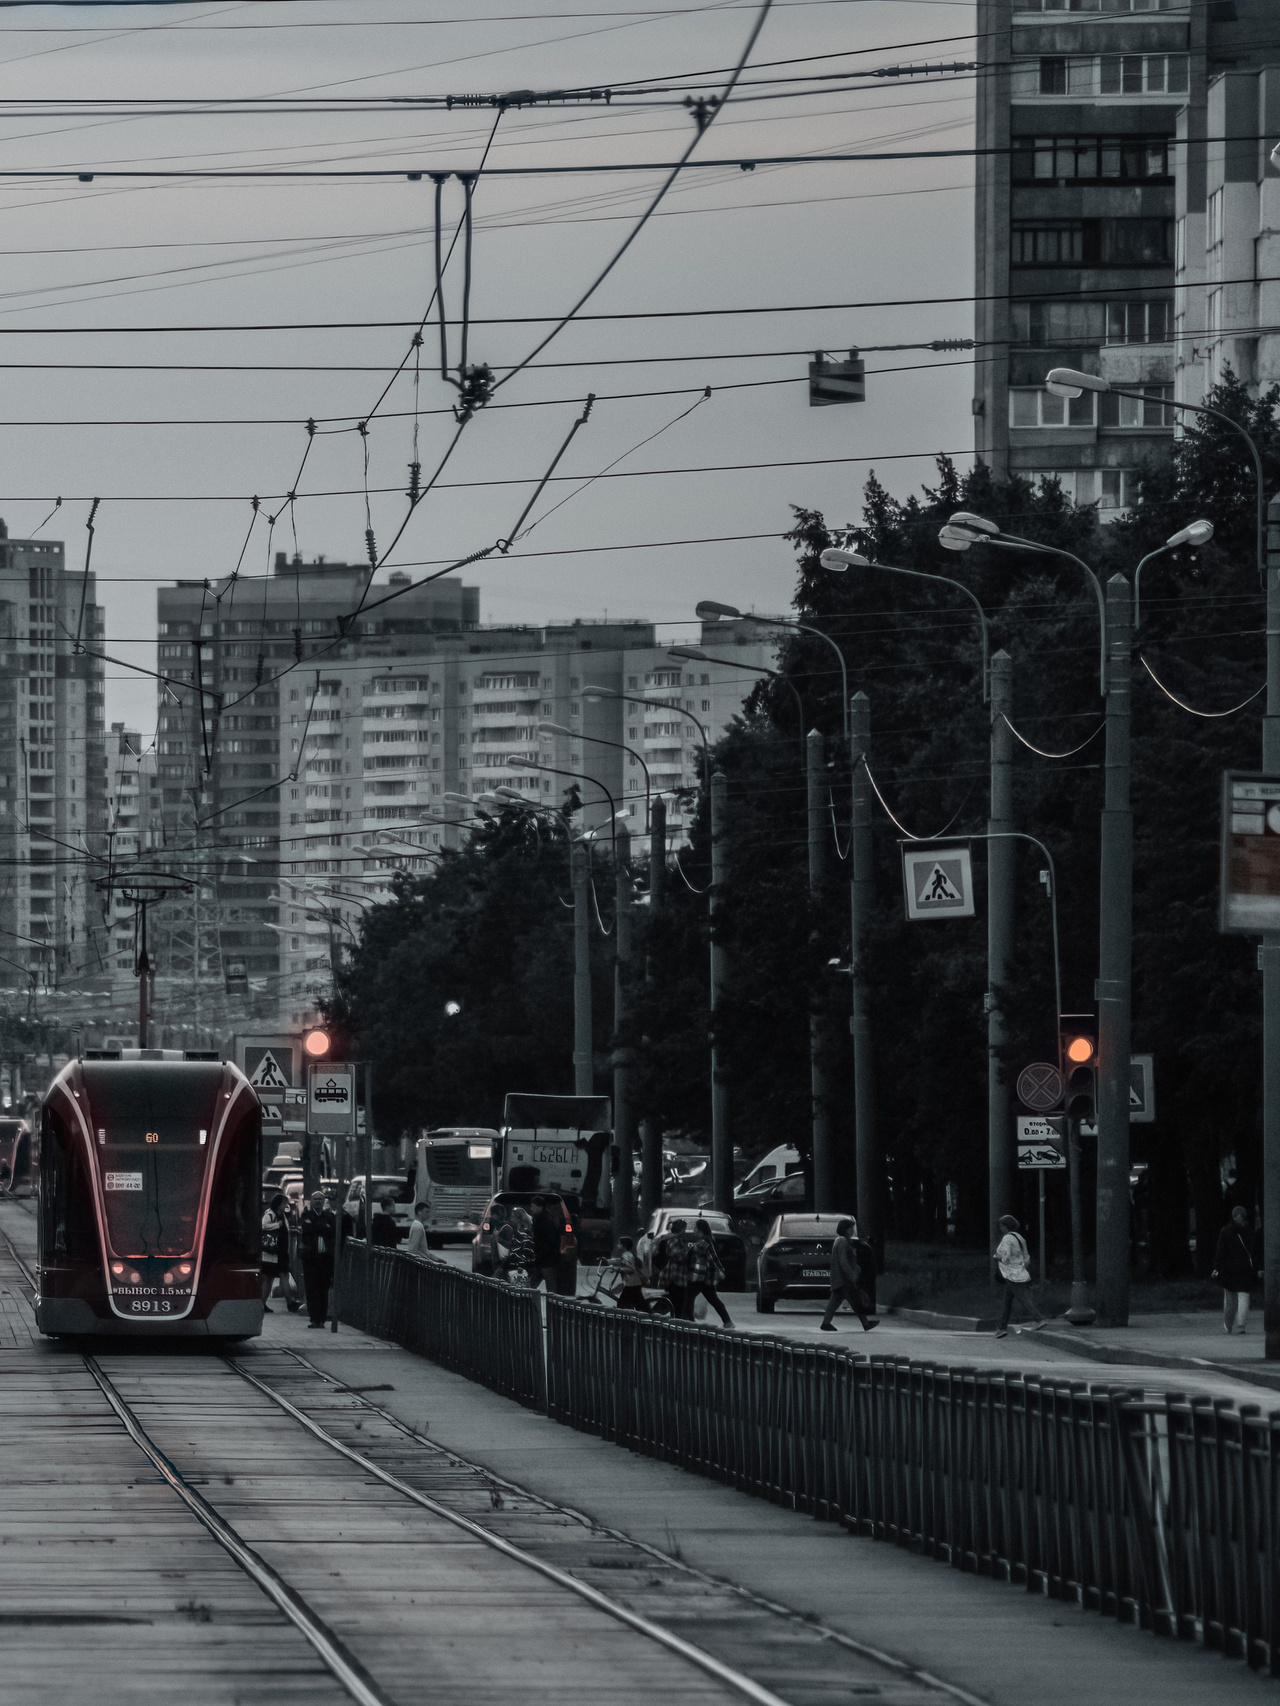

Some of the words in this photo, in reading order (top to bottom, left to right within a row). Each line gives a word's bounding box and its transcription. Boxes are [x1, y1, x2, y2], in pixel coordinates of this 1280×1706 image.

[146, 1133, 158, 1143] 60
[118, 1287, 158, 1295] ВЫНОС
[132, 1300, 171, 1312] 8913
